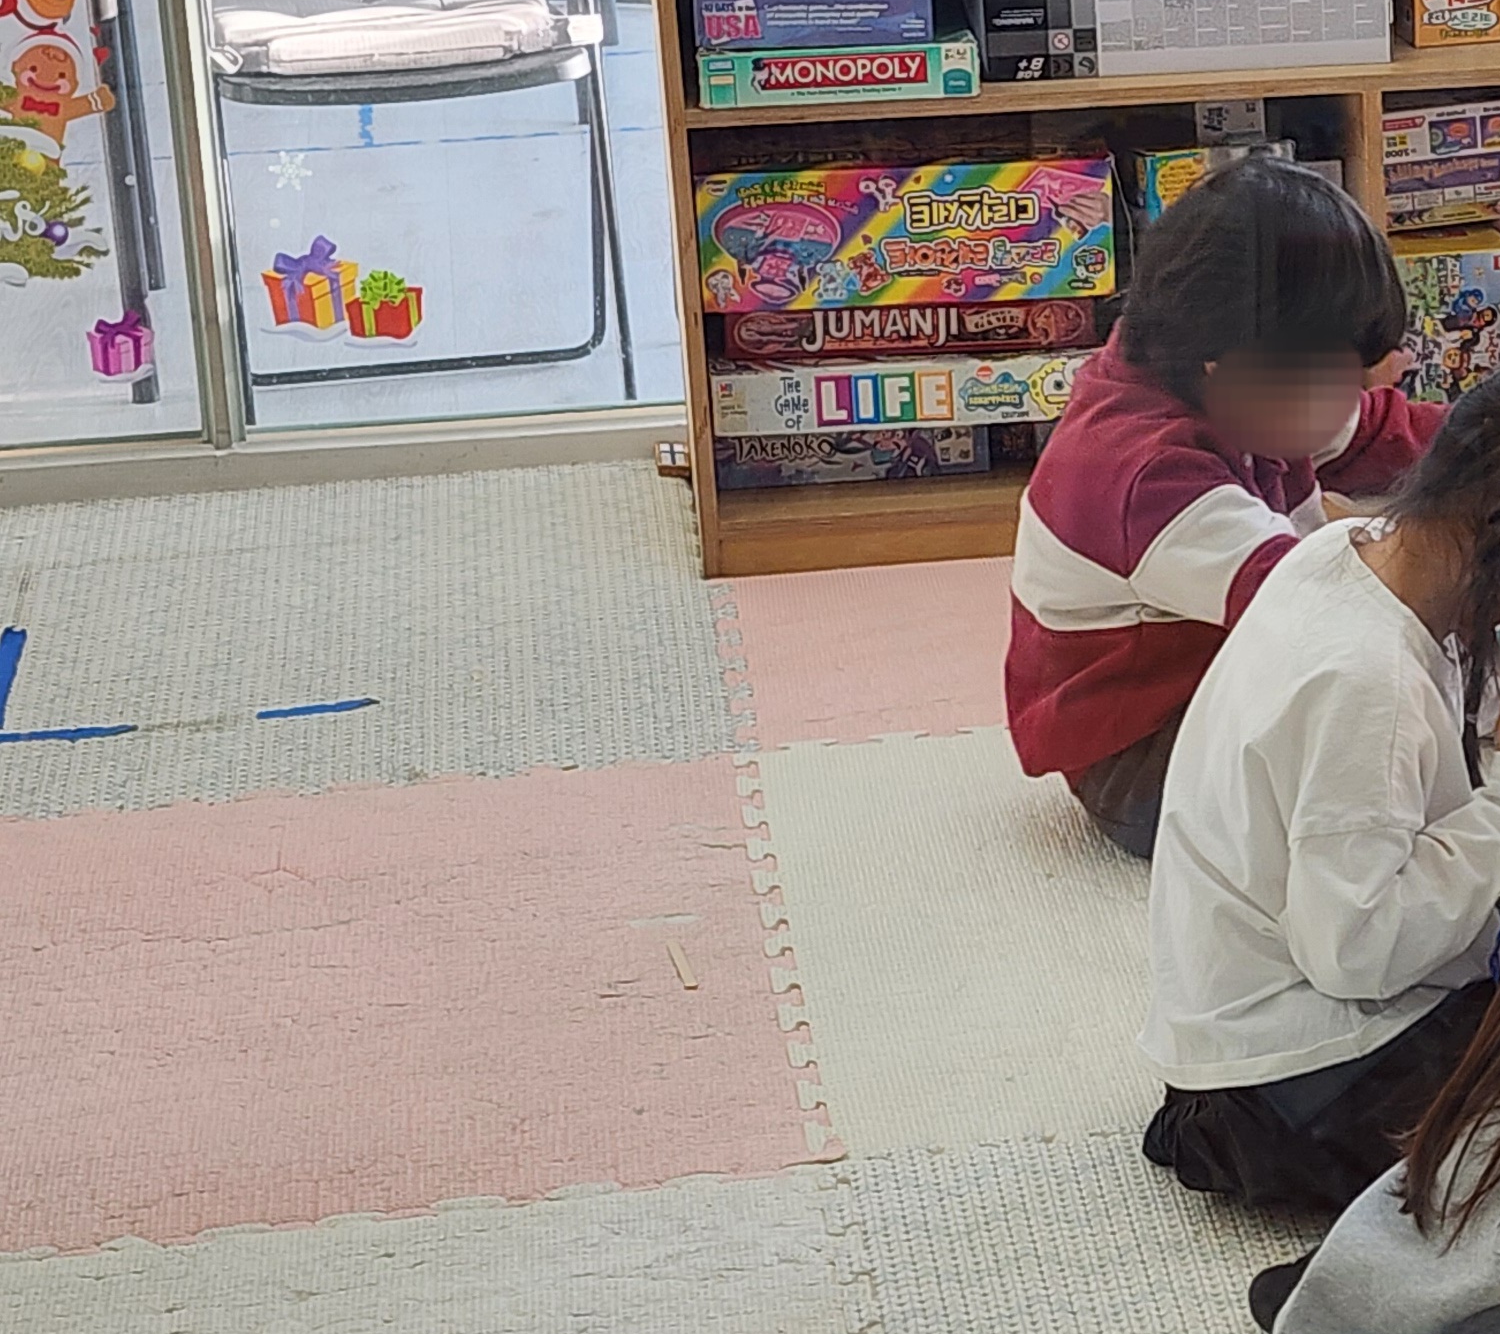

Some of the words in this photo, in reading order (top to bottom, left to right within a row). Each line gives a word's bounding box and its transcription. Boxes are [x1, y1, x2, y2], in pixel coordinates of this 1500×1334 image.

[703, 14, 762, 39] USA
[769, 55, 921, 86] MONOPOLY
[909, 192, 1036, 229] 디럭스세트
[802, 308, 960, 352] JUMANJI
[818, 376, 950, 423] LIFE
[731, 434, 837, 464] TAKENOKO
